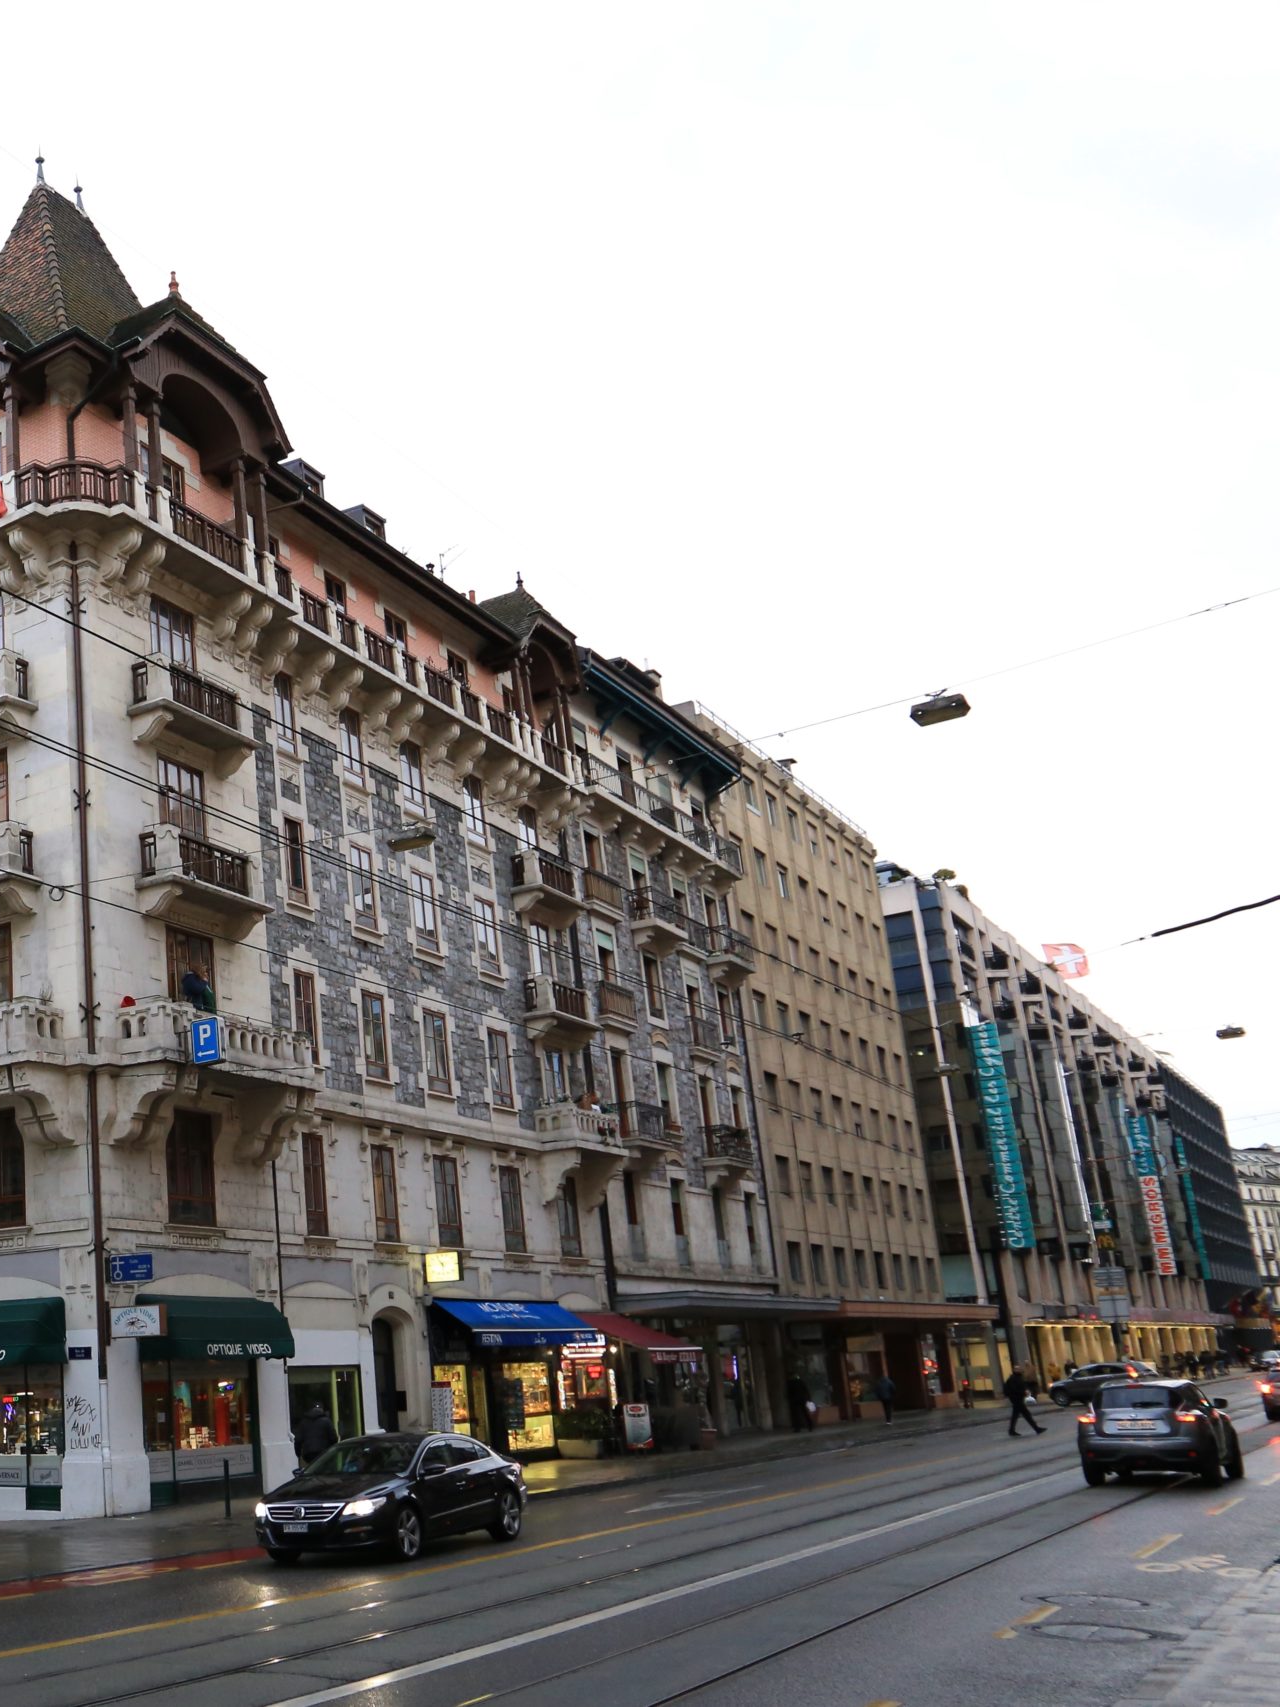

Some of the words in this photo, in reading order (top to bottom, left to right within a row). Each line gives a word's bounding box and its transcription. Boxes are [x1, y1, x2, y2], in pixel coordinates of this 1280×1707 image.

[199, 1024, 211, 1046] P
[987, 1107, 1015, 1194] Commercial
[1143, 1176, 1167, 1244] MIGROS
[113, 1308, 138, 1326] OPTIQUE
[139, 1307, 157, 1324] VIDEO
[207, 1343, 244, 1355] OPTIQUE
[245, 1343, 272, 1354] VIDEO
